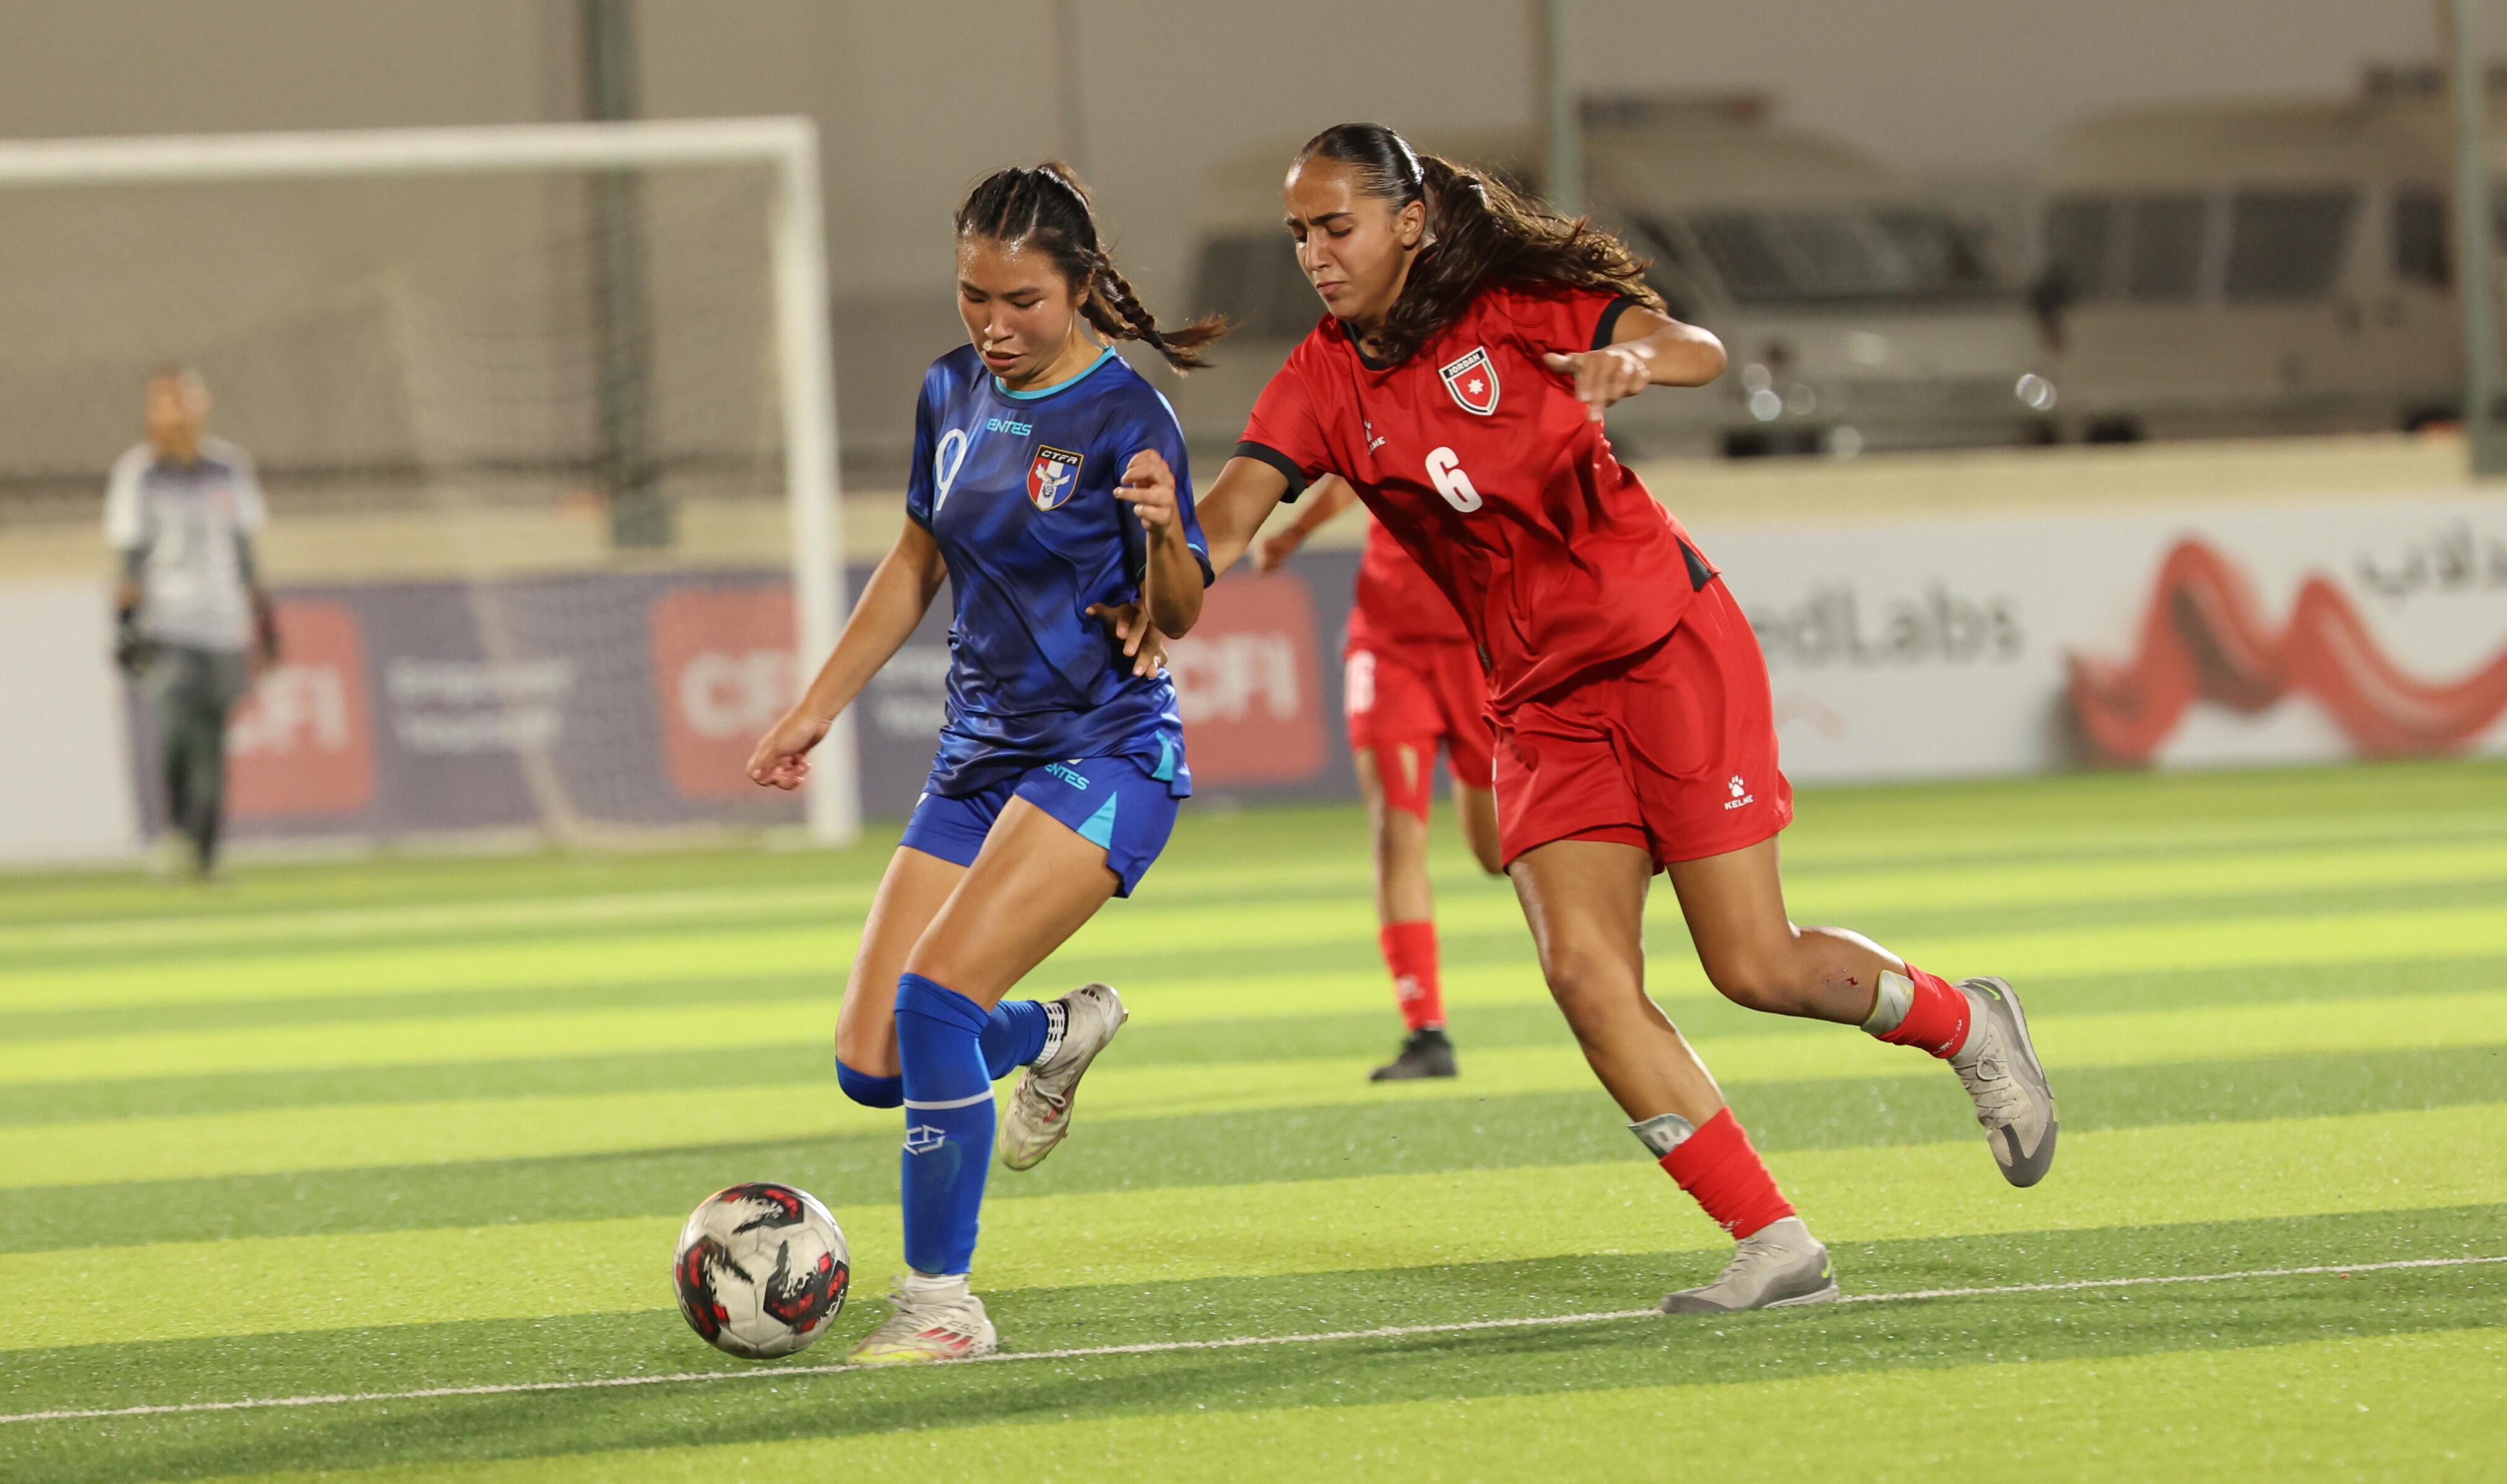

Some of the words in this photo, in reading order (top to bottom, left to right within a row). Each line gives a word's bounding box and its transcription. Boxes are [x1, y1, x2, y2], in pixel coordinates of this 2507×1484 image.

[1448, 353, 1480, 375] JORDAN
[986, 418, 1033, 436] ENTES
[1041, 450, 1078, 464] CTFA
[935, 428, 967, 511] 9
[1425, 447, 1483, 512] 6
[1724, 794, 1753, 810] KELME
